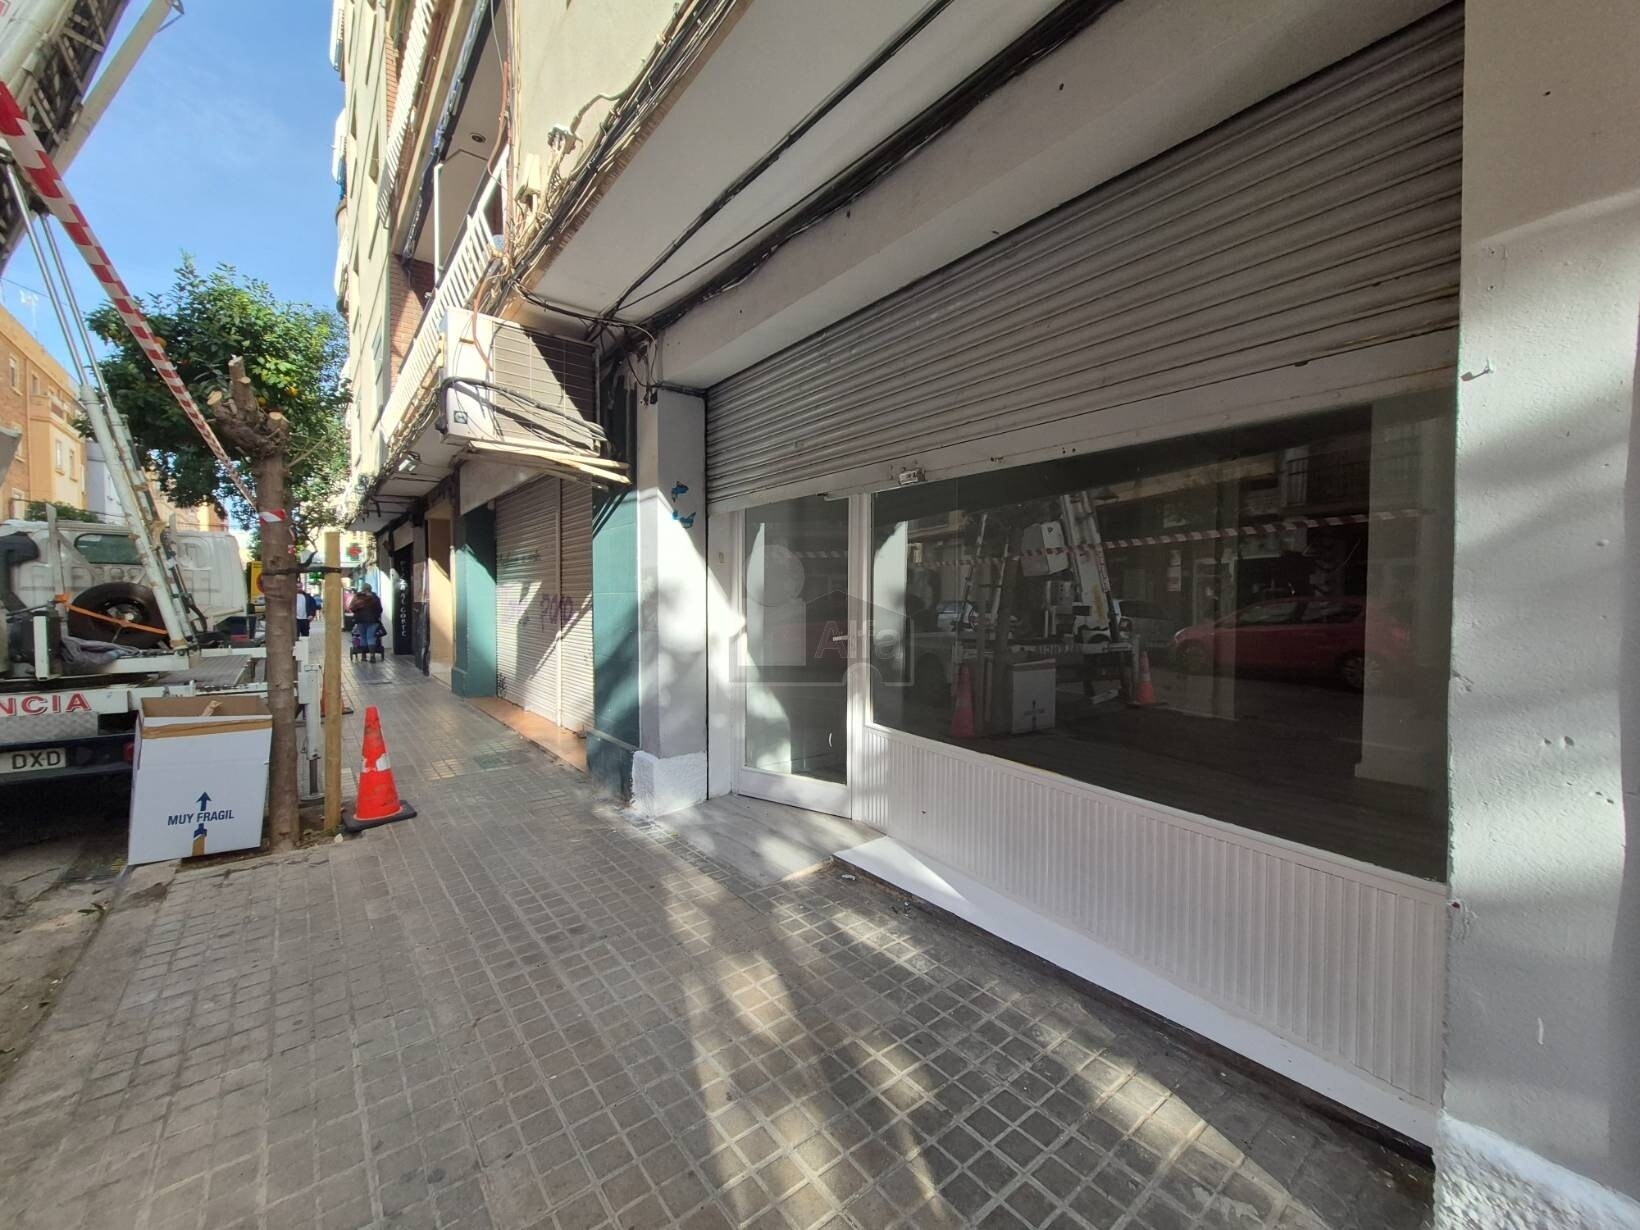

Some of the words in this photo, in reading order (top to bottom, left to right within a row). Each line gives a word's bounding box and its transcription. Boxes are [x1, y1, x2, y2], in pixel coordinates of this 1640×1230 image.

[12, 750, 61, 770] DXD
[167, 813, 194, 826] MUY
[196, 809, 235, 822] FRAGIL
